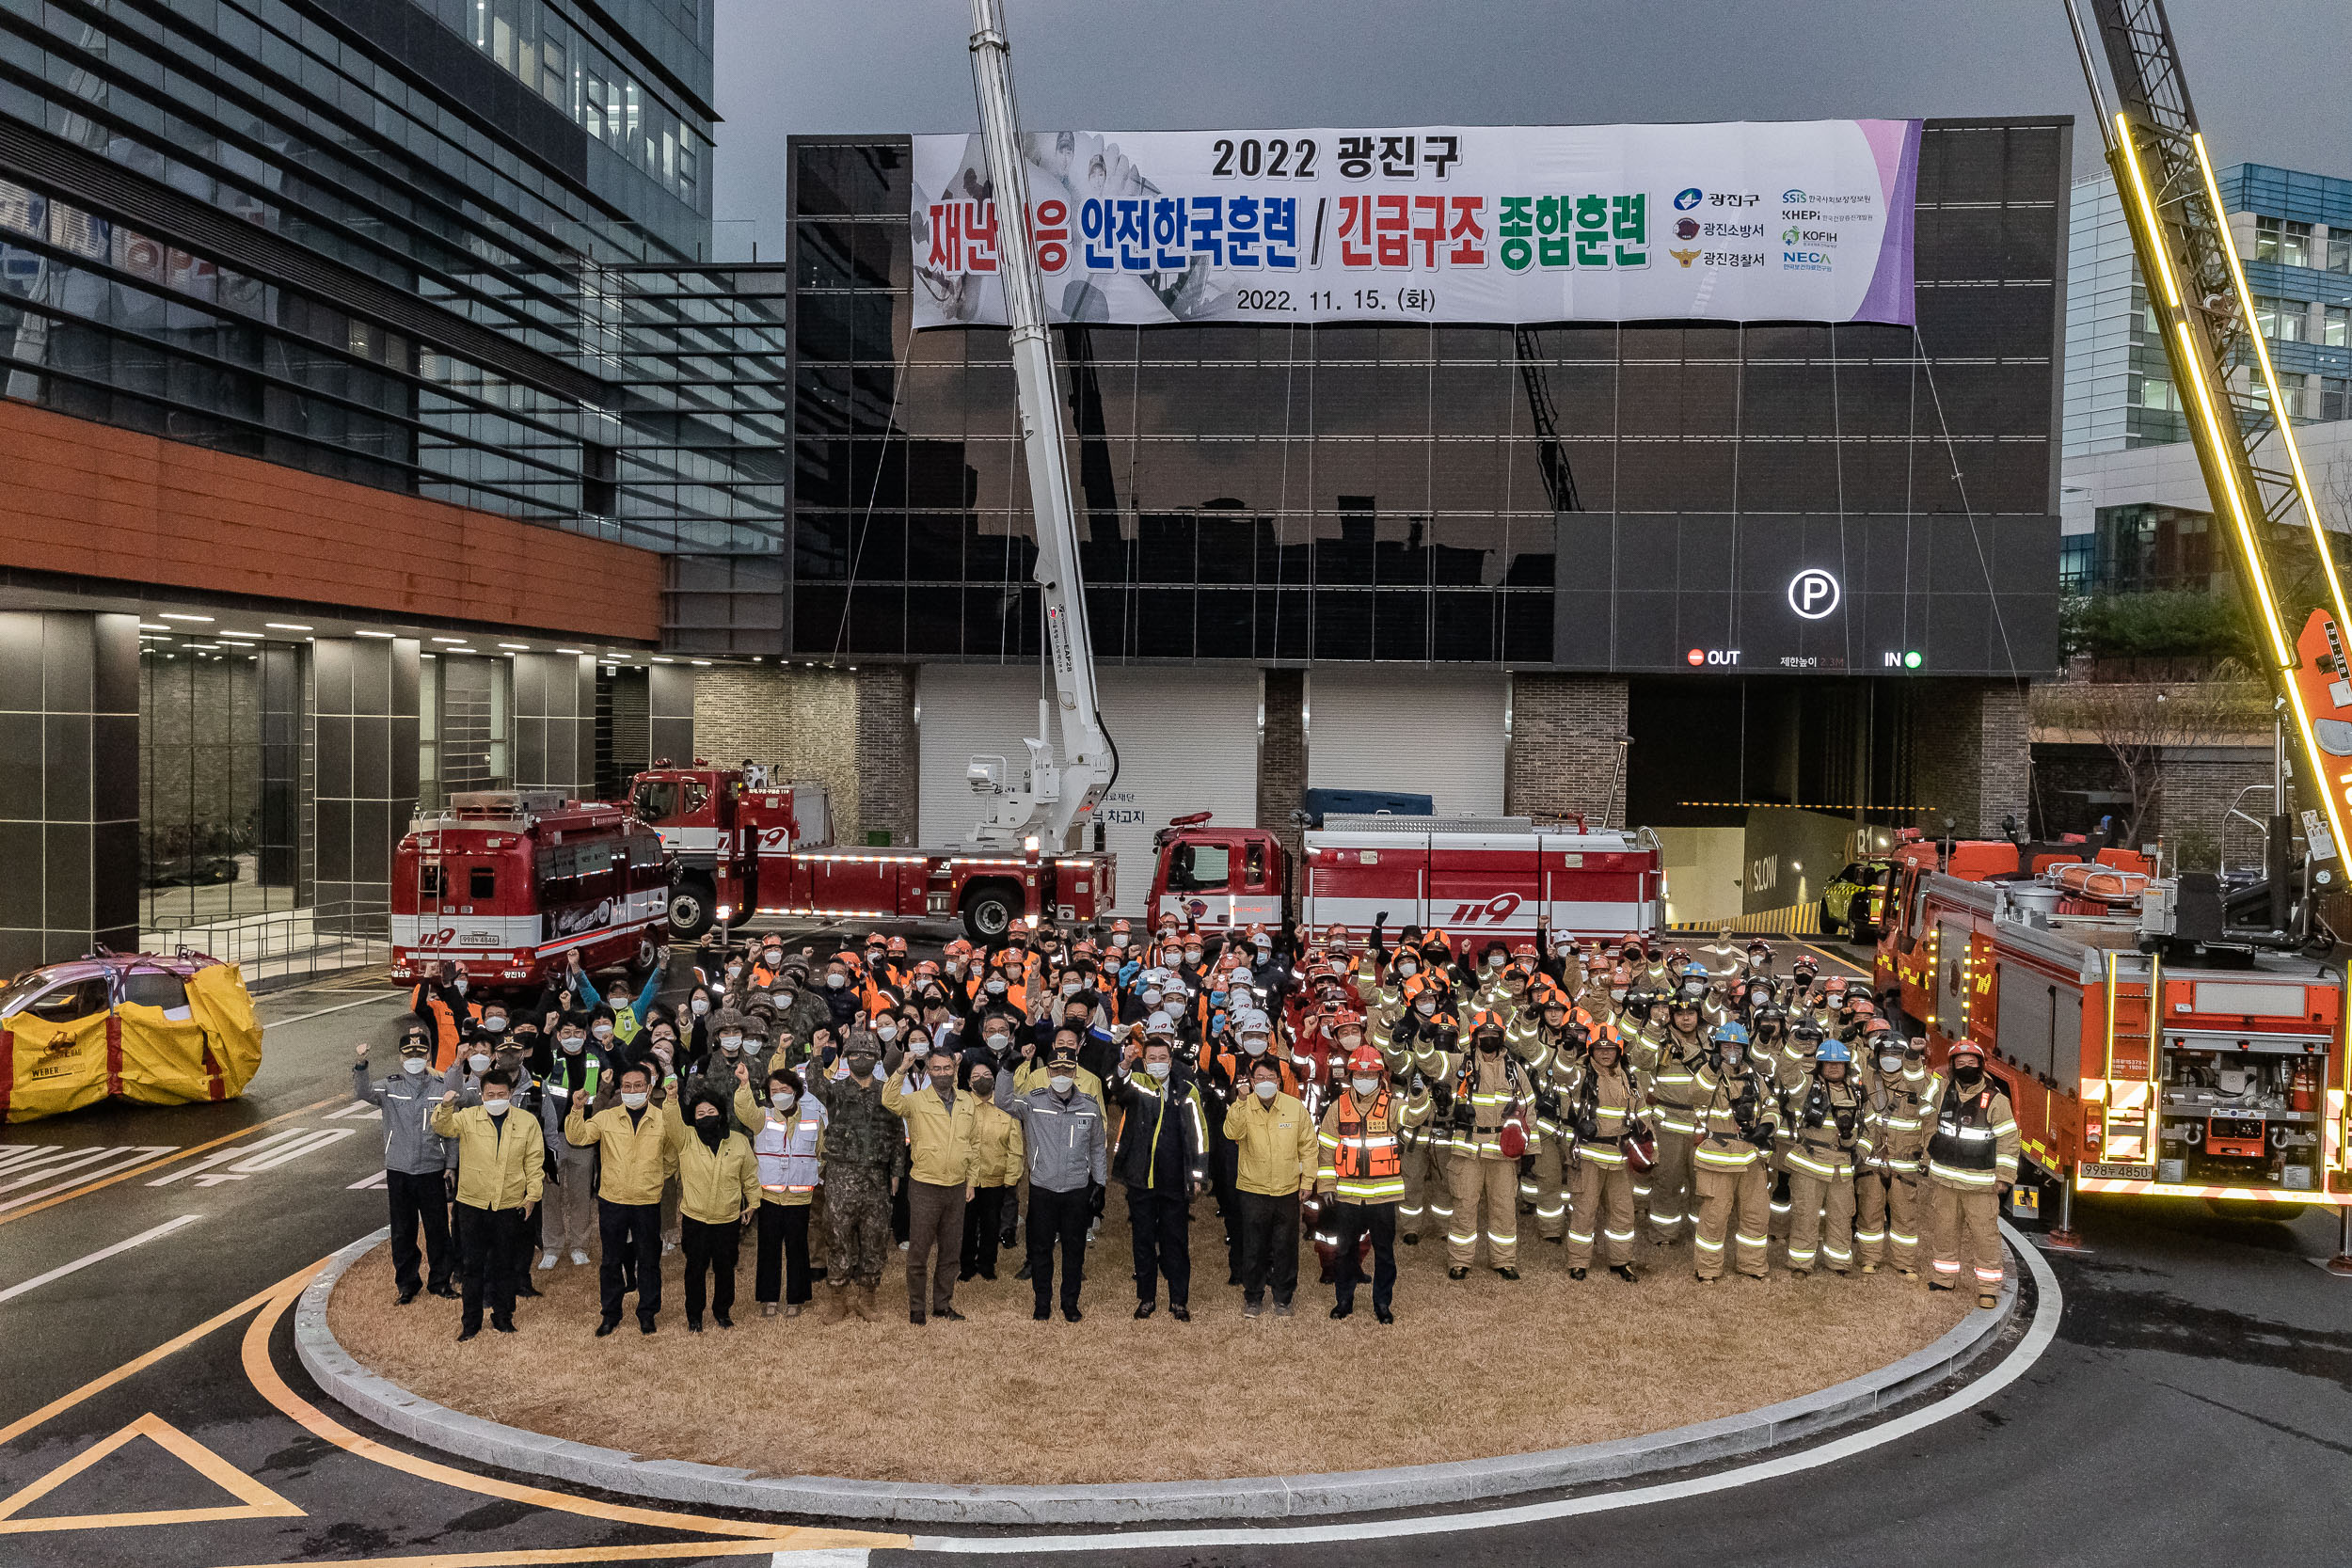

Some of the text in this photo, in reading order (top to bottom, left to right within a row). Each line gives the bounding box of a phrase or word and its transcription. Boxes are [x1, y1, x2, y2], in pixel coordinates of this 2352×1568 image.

[1213, 136, 1458, 178] 2022 광진구
[1708, 194, 1760, 207] 광진구
[928, 199, 1068, 272] 재난응
[1080, 195, 1297, 269] 안전한국훈련
[1337, 195, 1487, 268] 긴급구조
[1498, 192, 1647, 271] 종합훈련
[1703, 223, 1764, 238] 광진소방서
[1803, 230, 1837, 242] KOFIH
[1703, 252, 1765, 267] 광진경찰서
[1783, 252, 1831, 263] NECA
[1236, 288, 1436, 312] 2022. 11. 15. (화)
[1803, 577, 1828, 610] P
[1064, 643, 1073, 673] EAP28
[1708, 650, 1740, 665] OUT
[1780, 657, 1818, 667] 제한높이
[1884, 652, 1901, 667] IN
[1107, 809, 1145, 824] 차고지
[1754, 854, 1778, 892] SLOW
[1447, 892, 1523, 926] 119
[419, 927, 456, 946] 119
[480, 935, 497, 943] 4846
[503, 971, 527, 979] 광진10
[31, 1066, 59, 1078] WEBER
[2085, 1164, 2116, 1177] 998누
[2118, 1164, 2149, 1179] 4850
